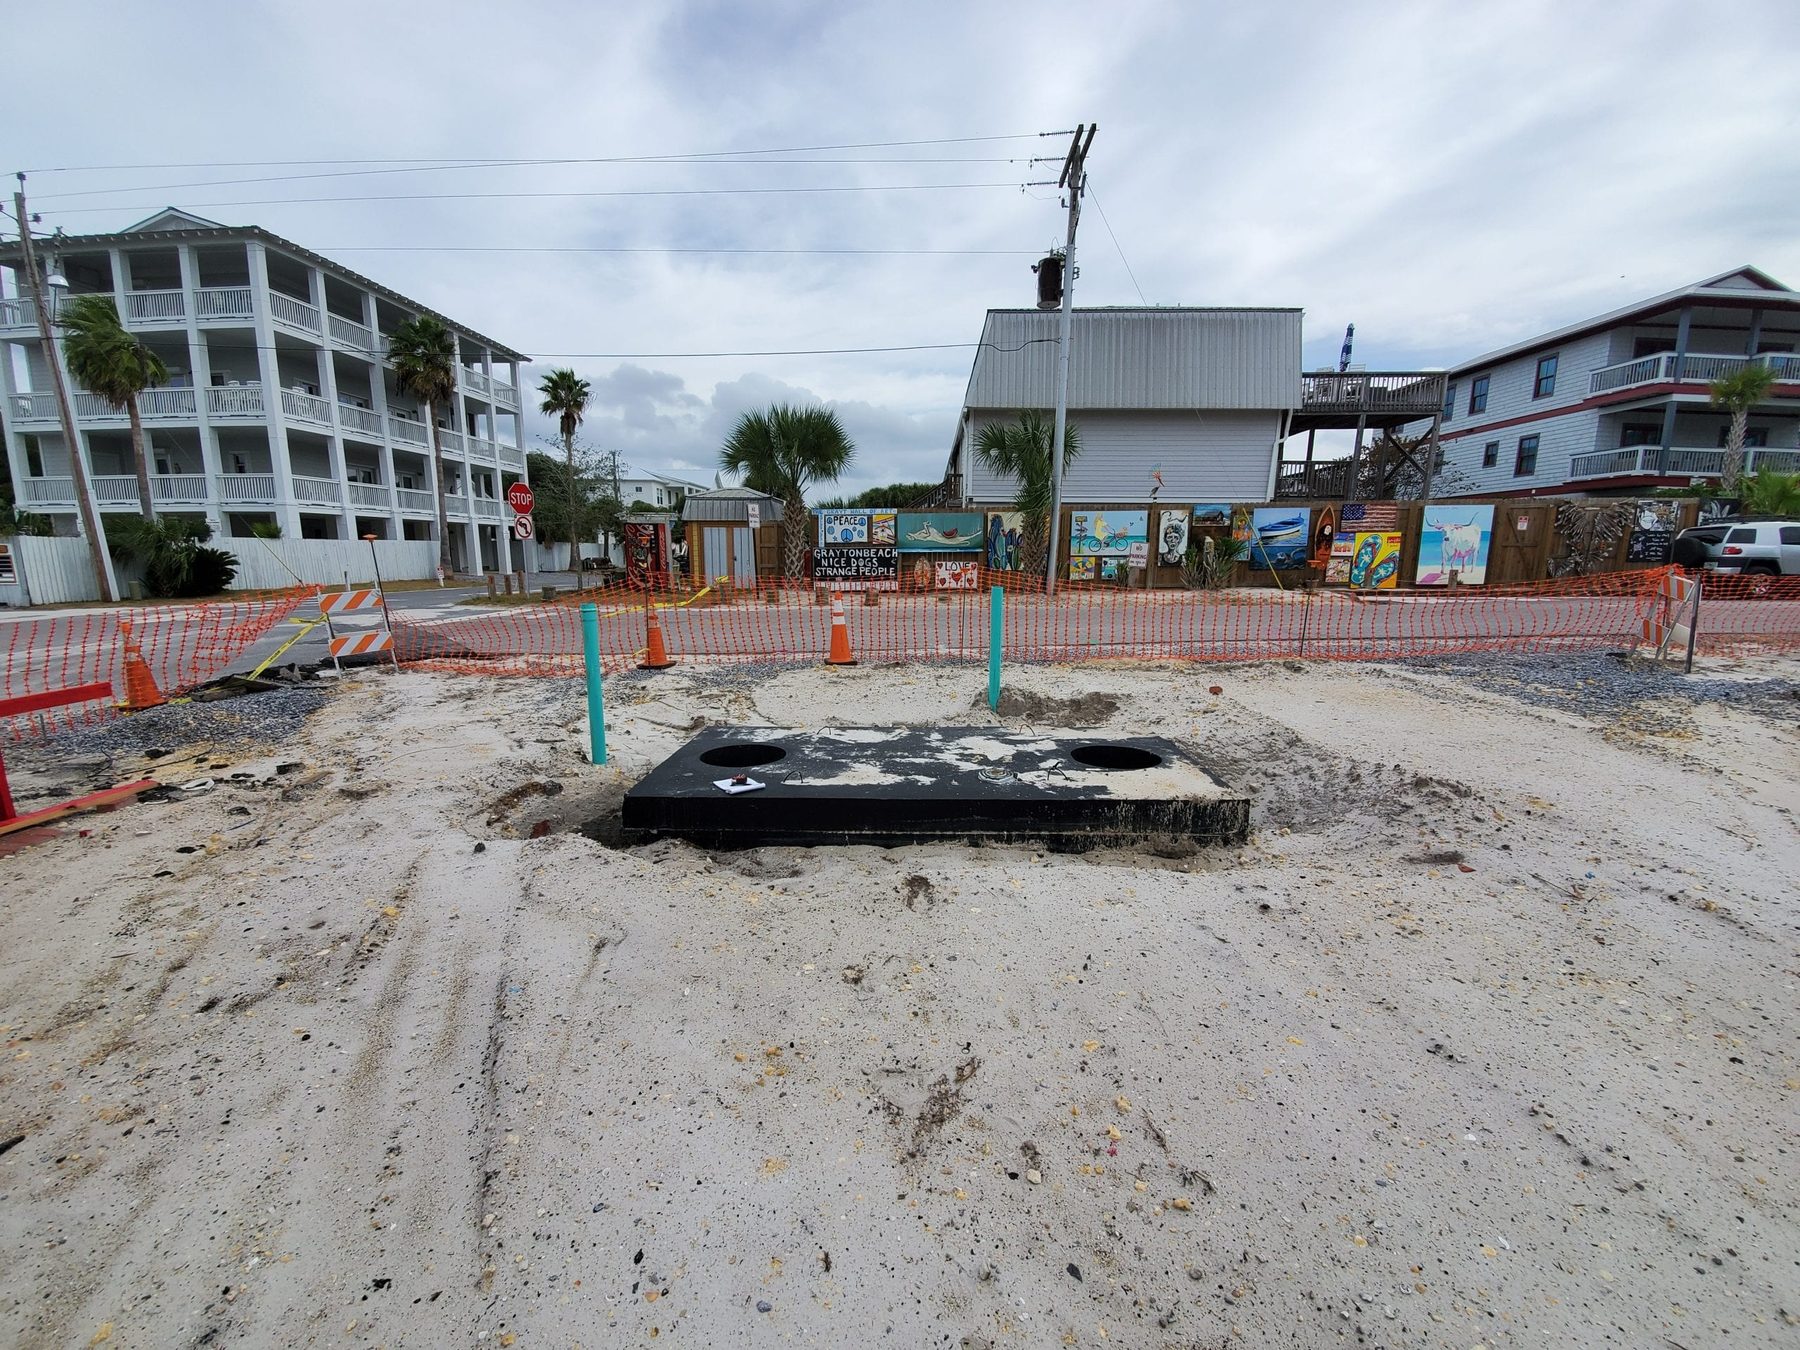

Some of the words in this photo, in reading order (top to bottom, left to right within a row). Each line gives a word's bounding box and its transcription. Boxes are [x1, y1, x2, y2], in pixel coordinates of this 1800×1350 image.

[510, 492, 532, 505] STOP
[833, 515, 859, 526] PEACE
[821, 558, 847, 567] NICE
[850, 558, 879, 567] DOGS
[945, 561, 970, 571] LOVE
[815, 567, 857, 576] STRANGE
[859, 567, 896, 576] PEOPLE
